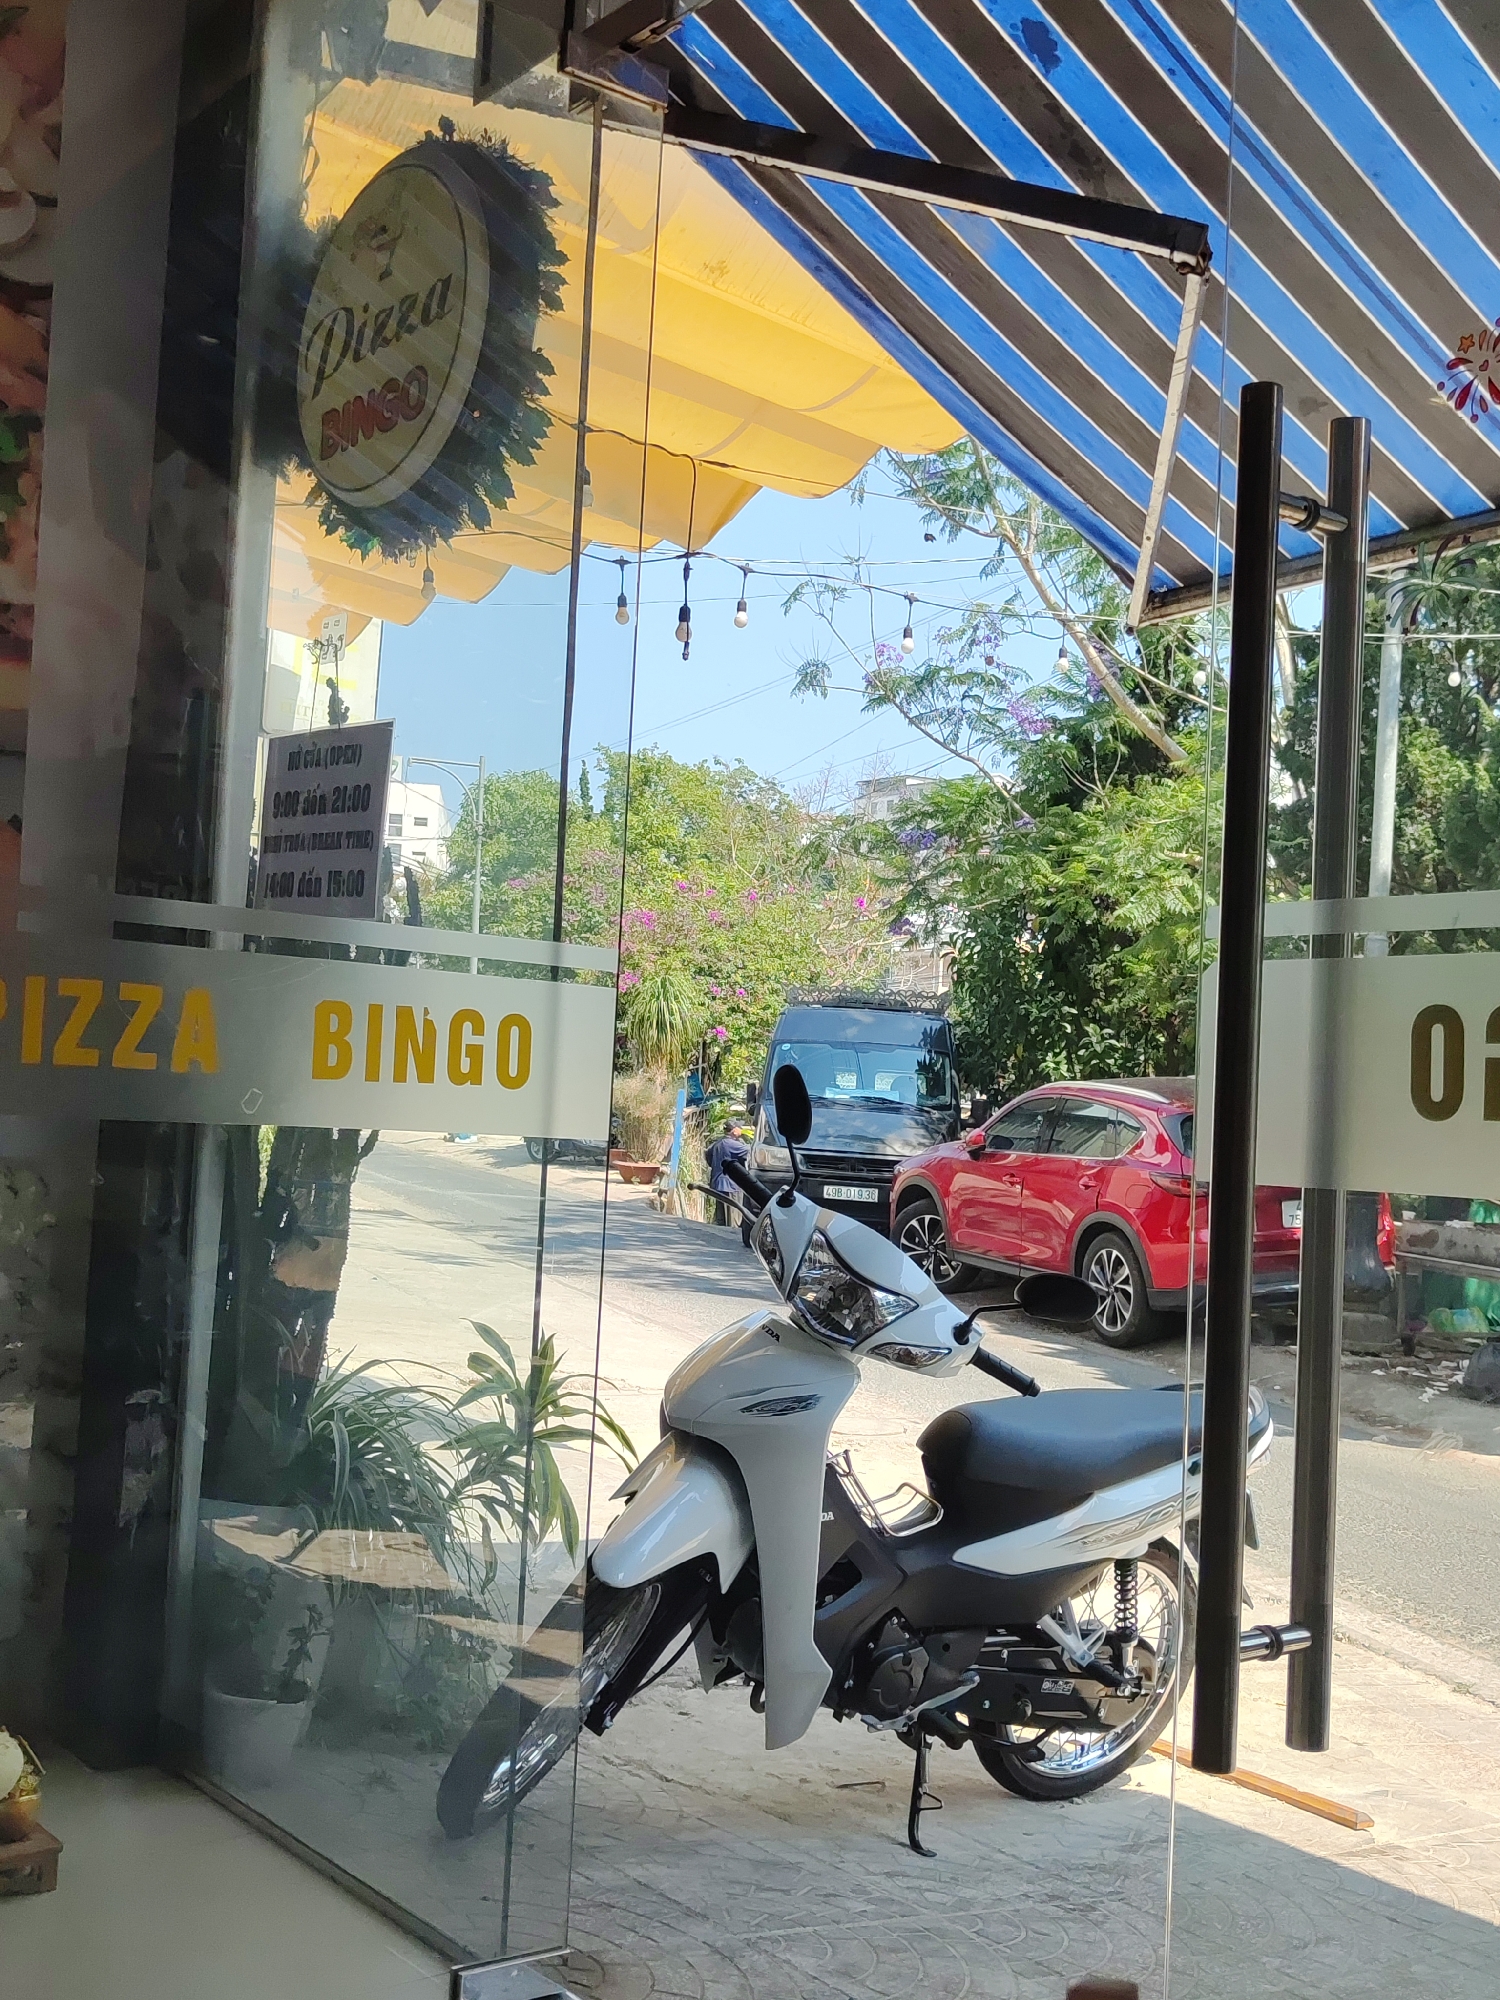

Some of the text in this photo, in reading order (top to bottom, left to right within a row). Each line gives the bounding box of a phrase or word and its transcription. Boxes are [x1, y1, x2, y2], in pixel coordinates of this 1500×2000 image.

[304, 272, 453, 400] Pizza
[320, 365, 429, 460] BINGO
[325, 744, 362, 770] (OPEN)
[273, 790, 299, 819] 9:00
[331, 783, 371, 813] 21:00
[327, 869, 364, 898] 15:00
[0, 974, 533, 1090] IZZA BINGO
